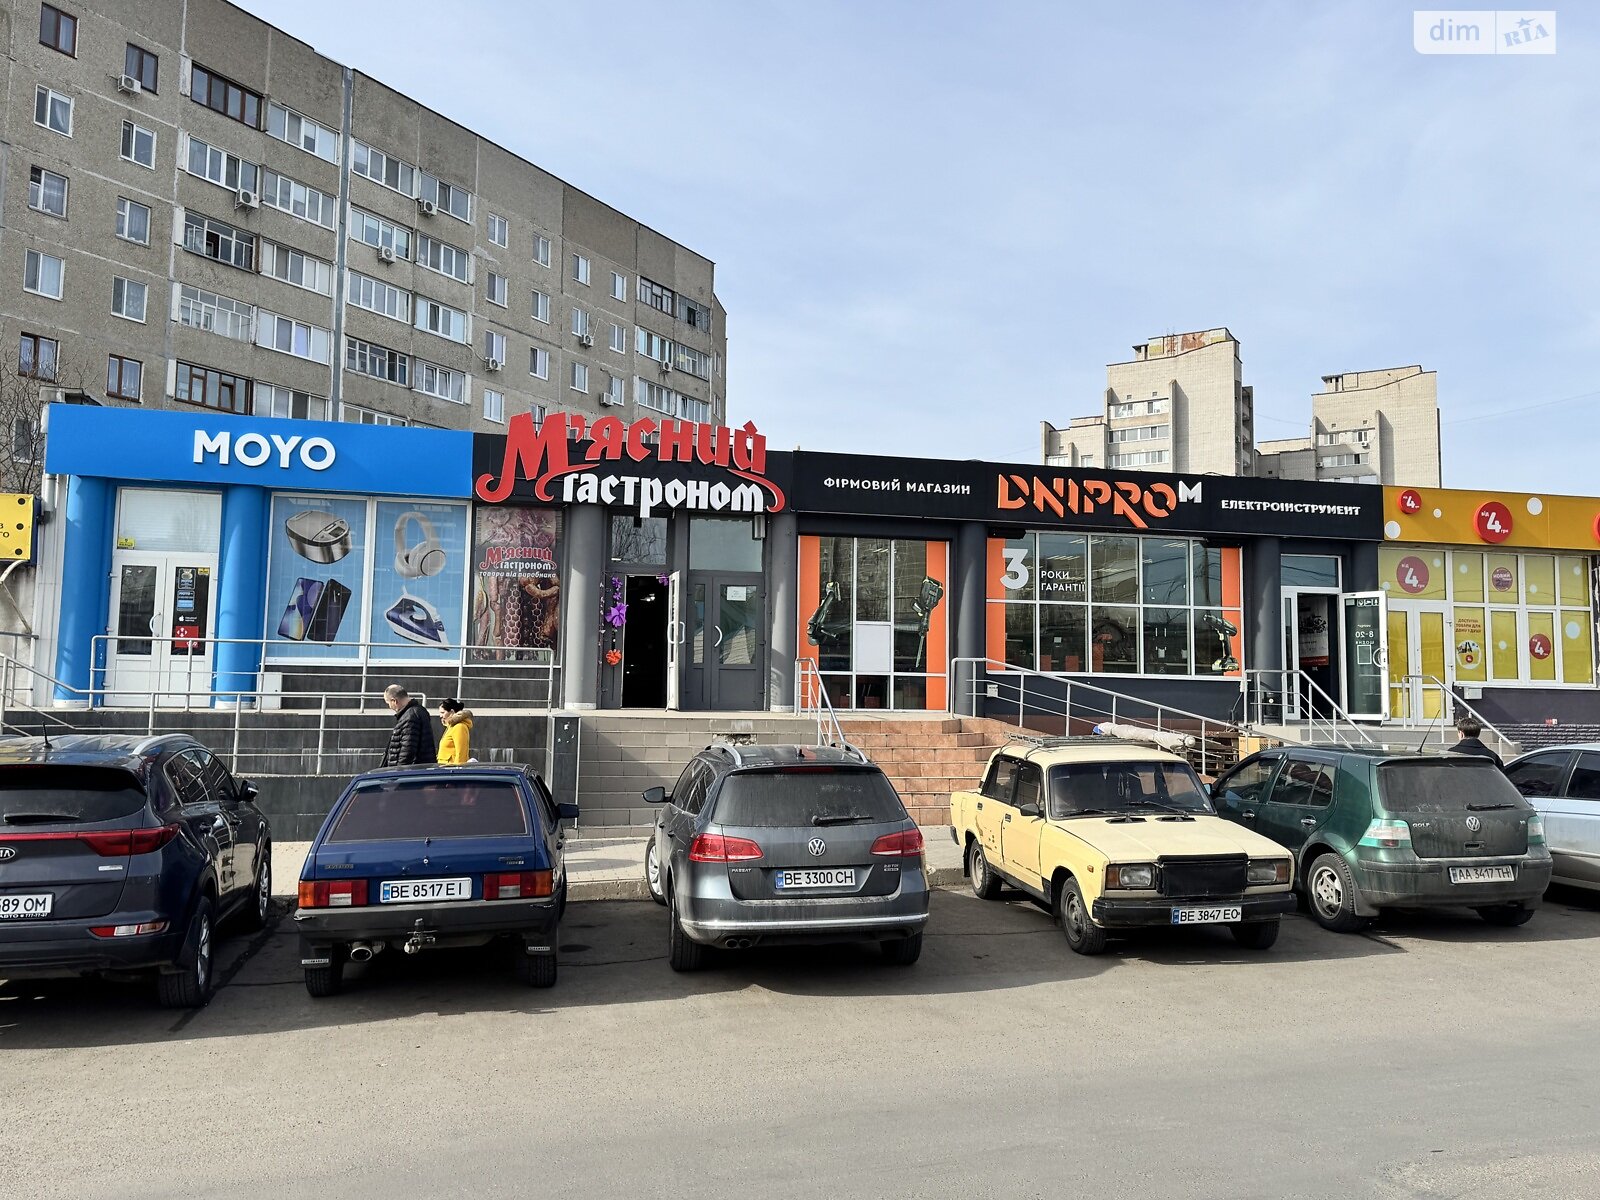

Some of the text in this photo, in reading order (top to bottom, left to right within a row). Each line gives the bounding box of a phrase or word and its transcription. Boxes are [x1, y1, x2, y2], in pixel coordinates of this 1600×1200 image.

[193, 429, 336, 471] MOYO
[823, 477, 971, 495] ФІРМОВИЙ МАГАЗИН
[1221, 499, 1361, 516] ЕЛЕКТРОІНСТРУМЕНТ
[1406, 495, 1416, 508] 4
[1486, 511, 1502, 533] 4
[999, 548, 1070, 590] 3 РОКИ
[1405, 567, 1418, 587] 4
[1041, 582, 1086, 593] ГАРАНТІЇ
[785, 871, 853, 885] BE 3300 CH
[1458, 869, 1472, 879] AA
[1474, 869, 1494, 879] 3417
[391, 885, 409, 898] BE
[413, 884, 443, 897] 8517
[0, 898, 47, 912] 89 OM
[1180, 909, 1238, 922] BE 3847 EO
